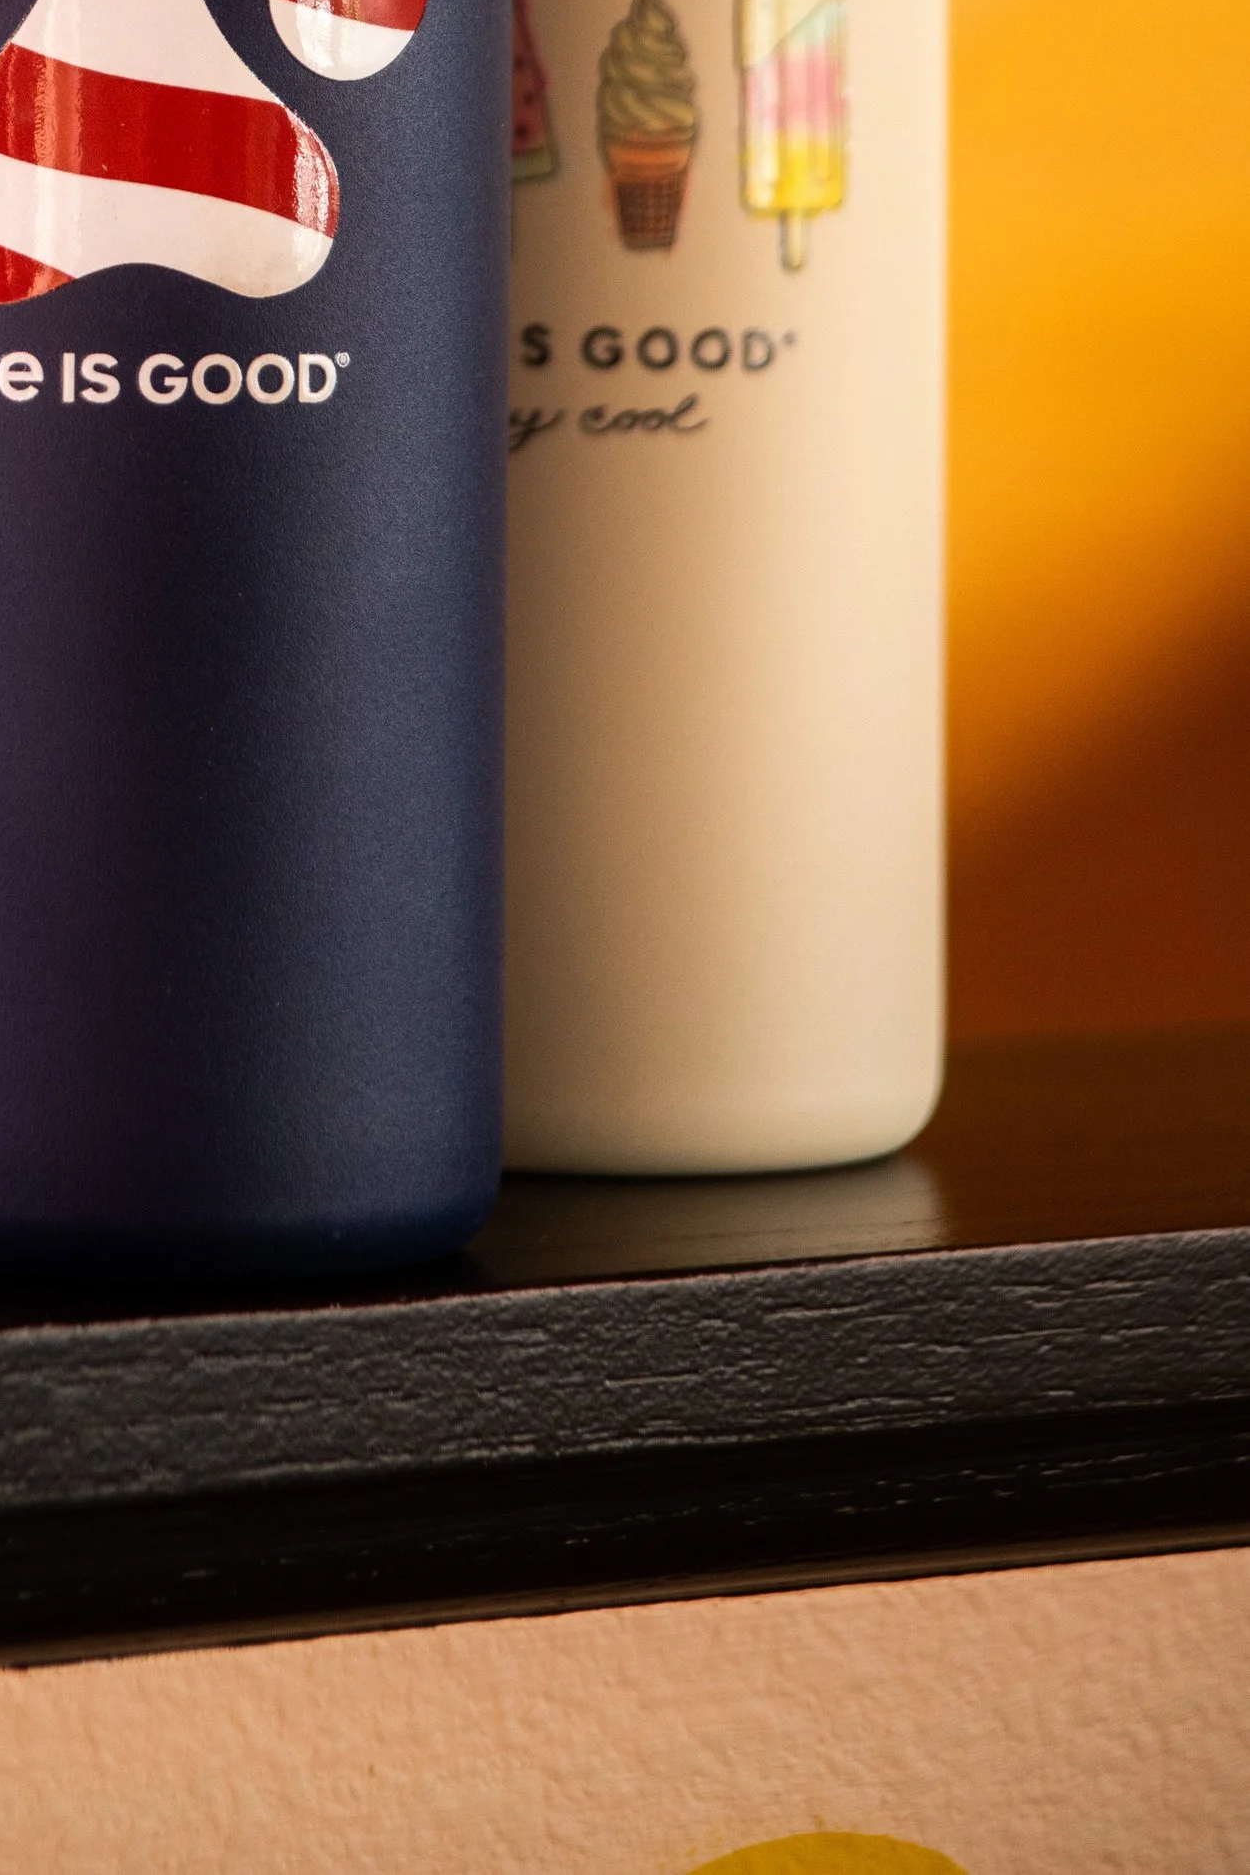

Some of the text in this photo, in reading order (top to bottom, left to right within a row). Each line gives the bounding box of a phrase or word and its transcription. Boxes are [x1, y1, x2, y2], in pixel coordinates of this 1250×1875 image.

[520, 322, 551, 368] S
[61, 351, 120, 404] IS
[578, 393, 708, 437] cool
